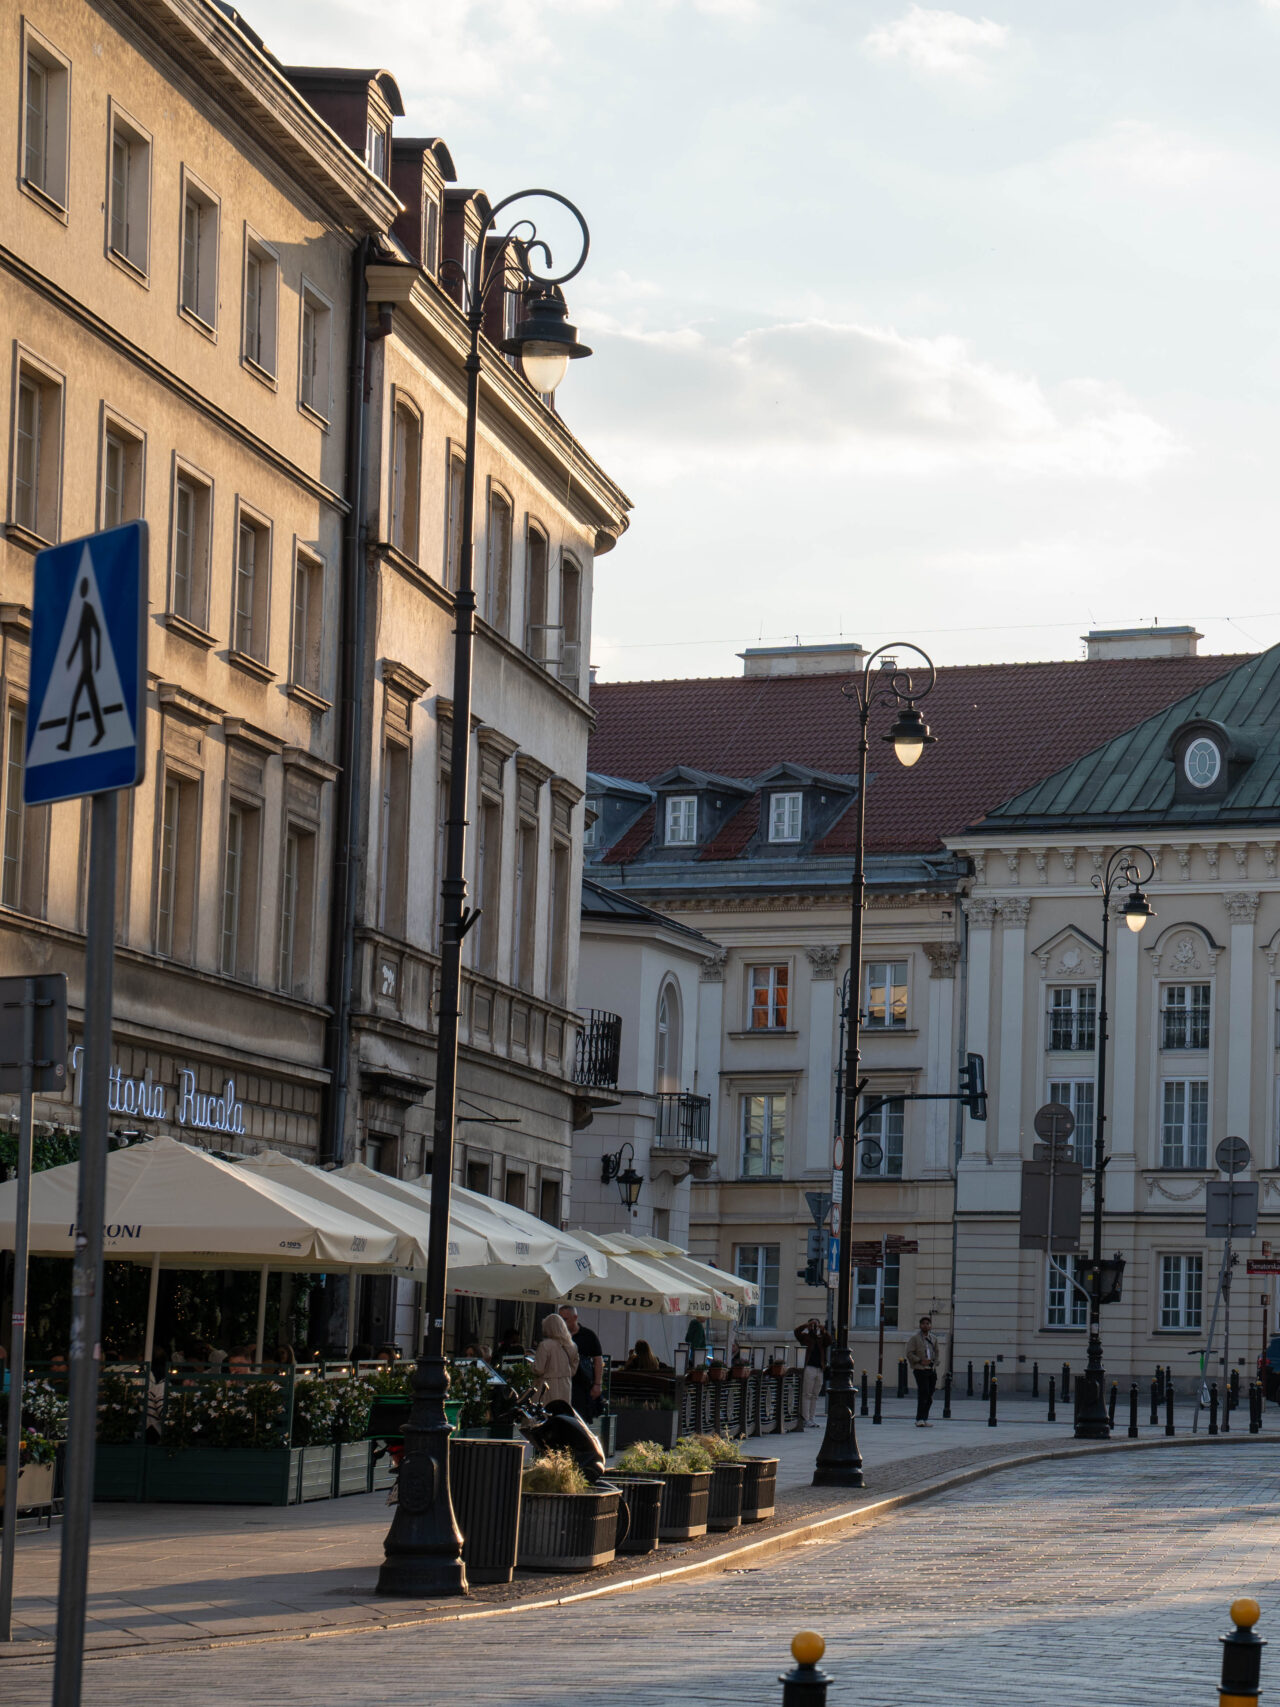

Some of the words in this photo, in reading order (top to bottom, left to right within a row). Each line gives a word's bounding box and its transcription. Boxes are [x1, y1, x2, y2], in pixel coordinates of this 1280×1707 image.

[179, 1067, 245, 1134] Rucola
[567, 1290, 602, 1303] ish
[610, 1294, 653, 1308] Pub
